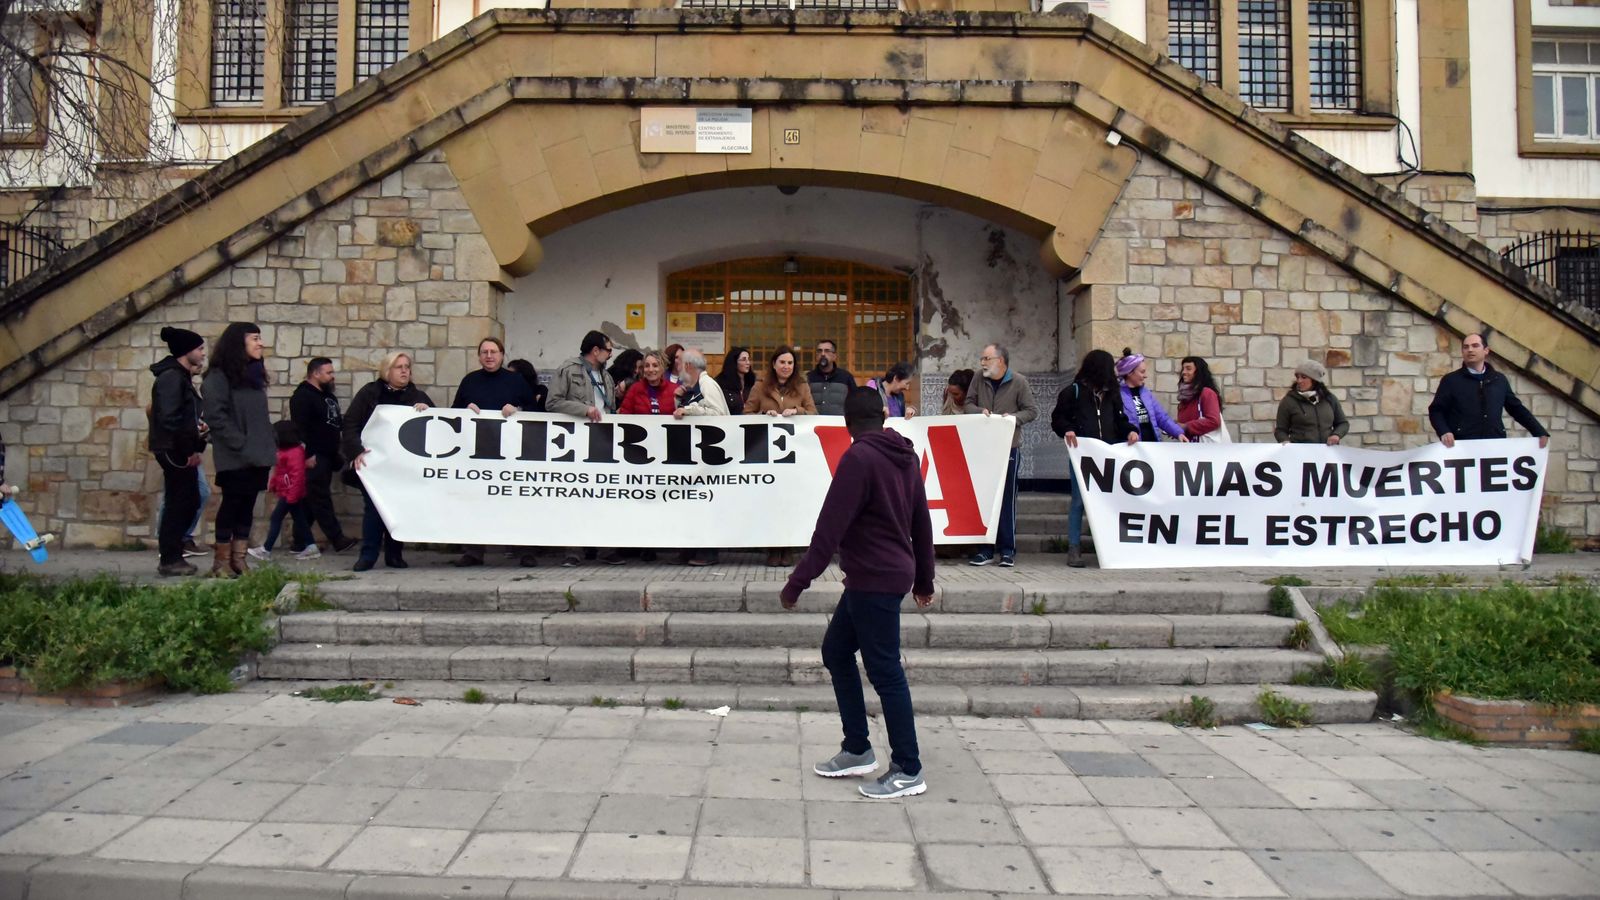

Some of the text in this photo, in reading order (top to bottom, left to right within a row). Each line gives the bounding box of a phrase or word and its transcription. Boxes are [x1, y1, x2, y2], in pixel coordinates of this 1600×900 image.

[786, 131, 798, 142] 46
[398, 415, 796, 466] CIERRE
[423, 467, 776, 486] DE LOS CENTROS DE INTERNAMIENTO
[1080, 455, 1539, 499] NO MAS MUERTES
[487, 485, 714, 503] DE EXTRANJEROS (CIEs)
[1118, 509, 1502, 547] EN EL ESTRECHO
